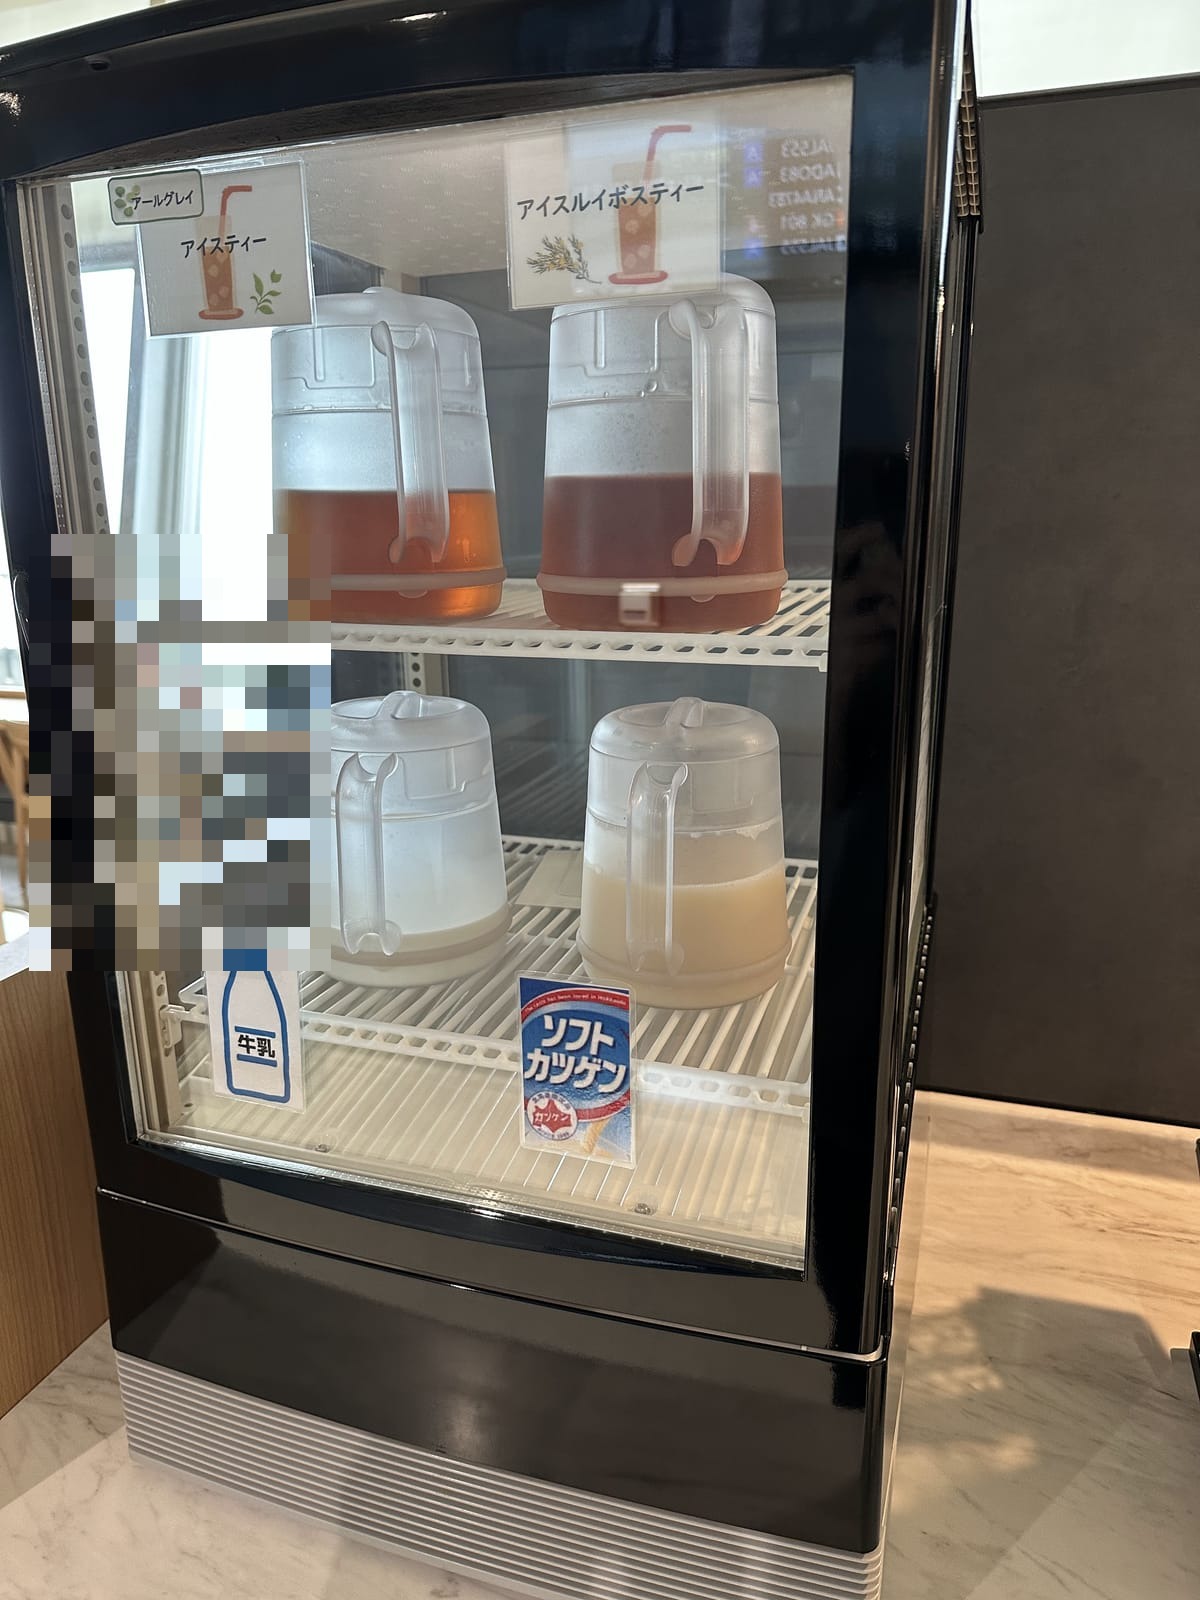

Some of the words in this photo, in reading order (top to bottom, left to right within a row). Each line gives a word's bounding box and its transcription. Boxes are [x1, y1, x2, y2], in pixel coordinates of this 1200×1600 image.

[132, 190, 194, 210] アールグレイ
[517, 182, 704, 220] アイスルイボスティー
[181, 235, 267, 258] アイスティー
[237, 1034, 276, 1058] 牛乳
[541, 1014, 614, 1055] ソフト
[524, 1048, 626, 1093] カツゲン
